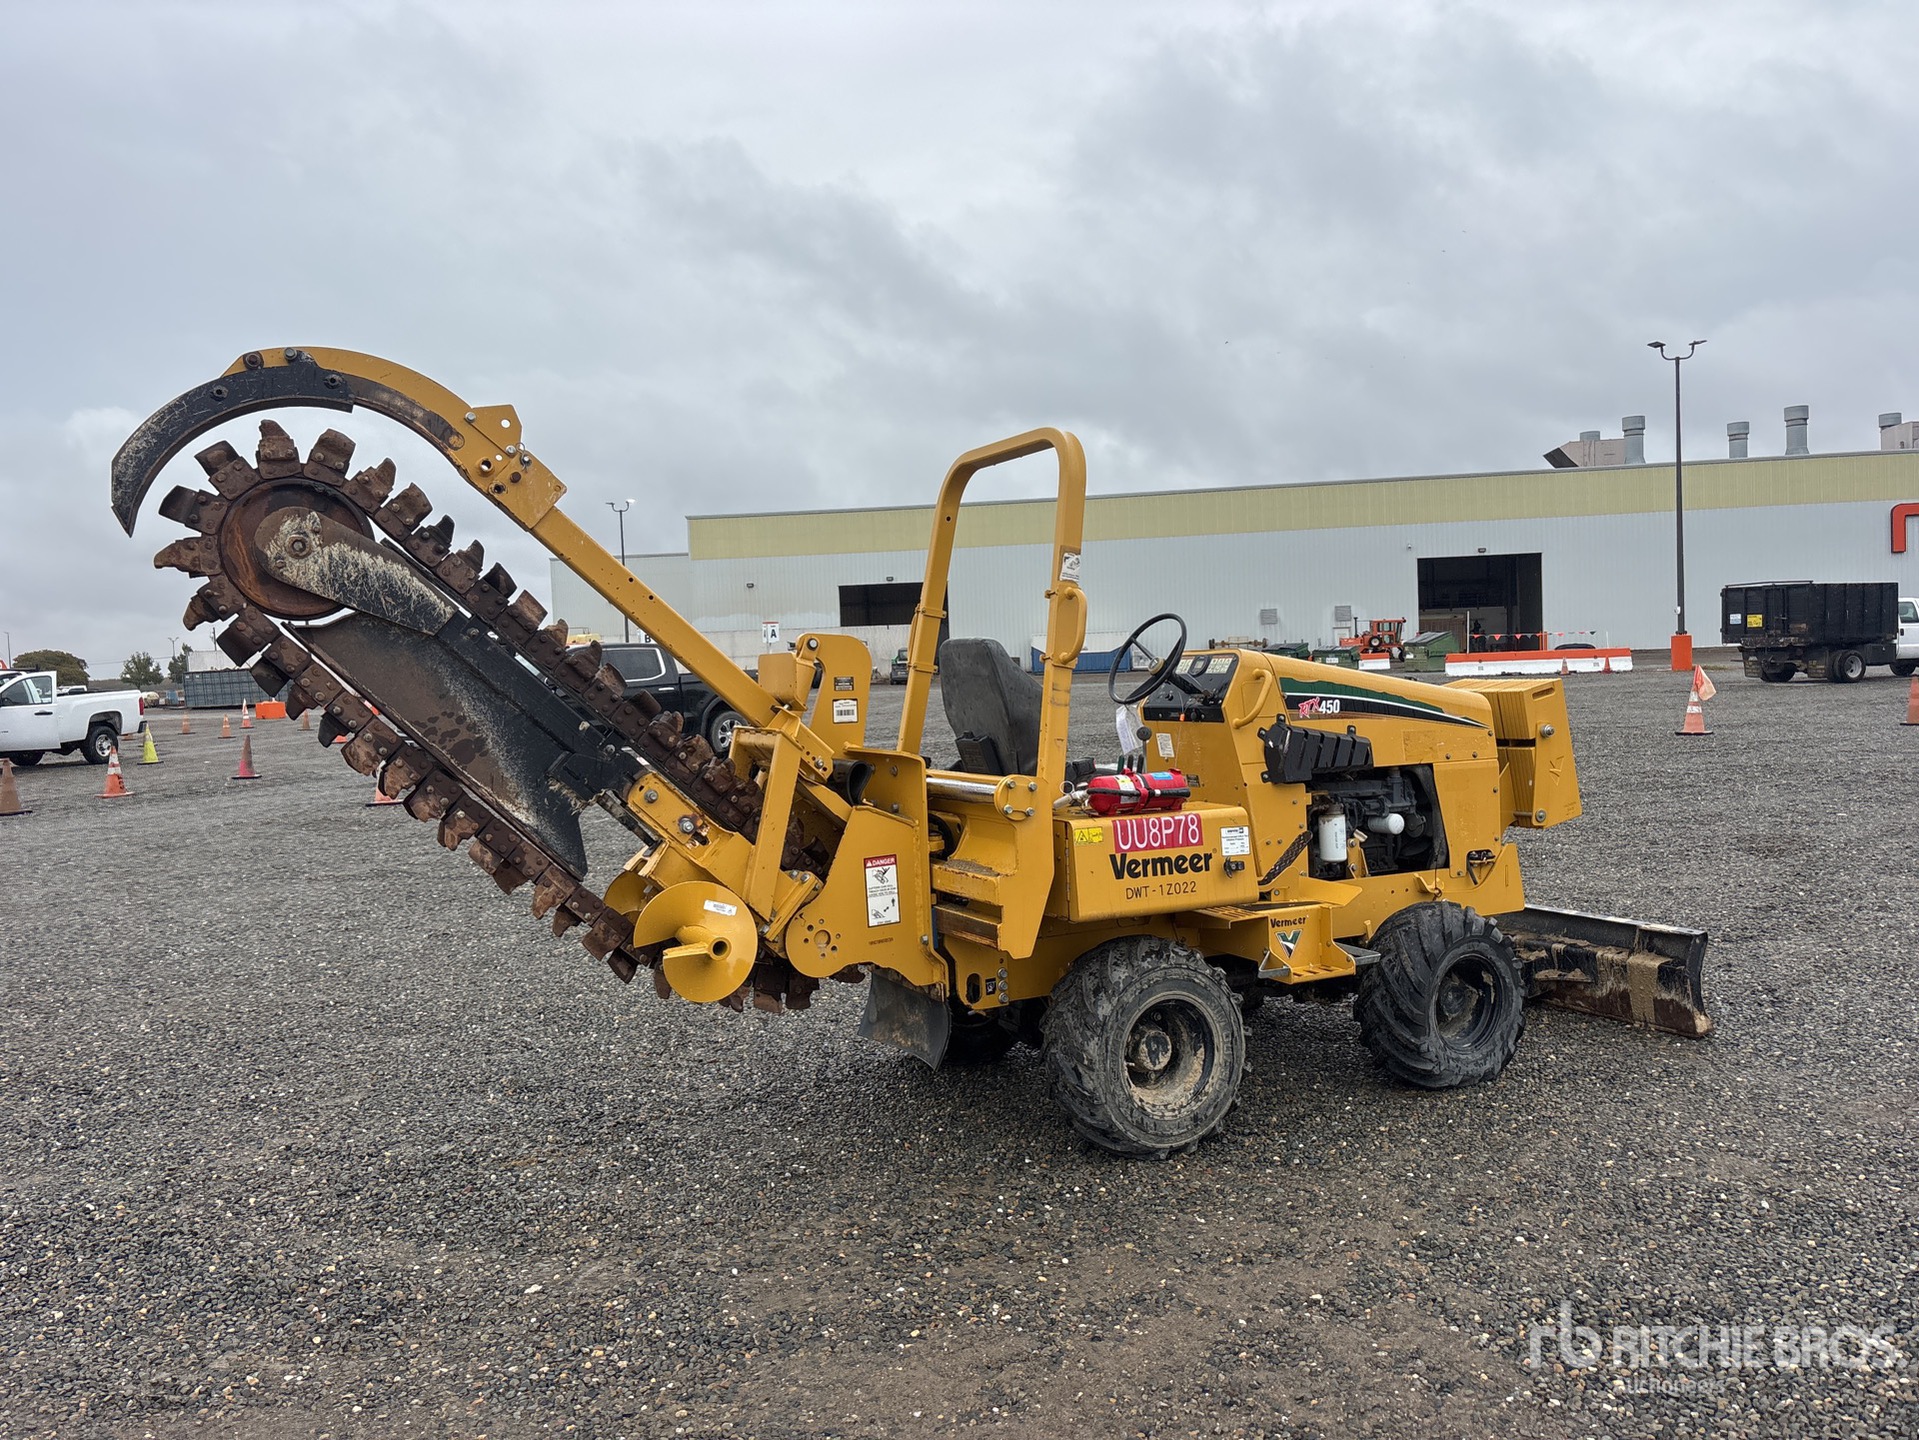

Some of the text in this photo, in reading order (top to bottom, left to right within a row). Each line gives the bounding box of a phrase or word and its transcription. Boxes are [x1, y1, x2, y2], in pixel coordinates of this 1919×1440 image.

[770, 628, 777, 638] A
[1319, 699, 1340, 714] 450
[1116, 814, 1200, 850] UU8P78
[871, 857, 895, 867] DANGER
[1109, 852, 1213, 880] Vermeer
[1270, 917, 1306, 928] Vermeer
